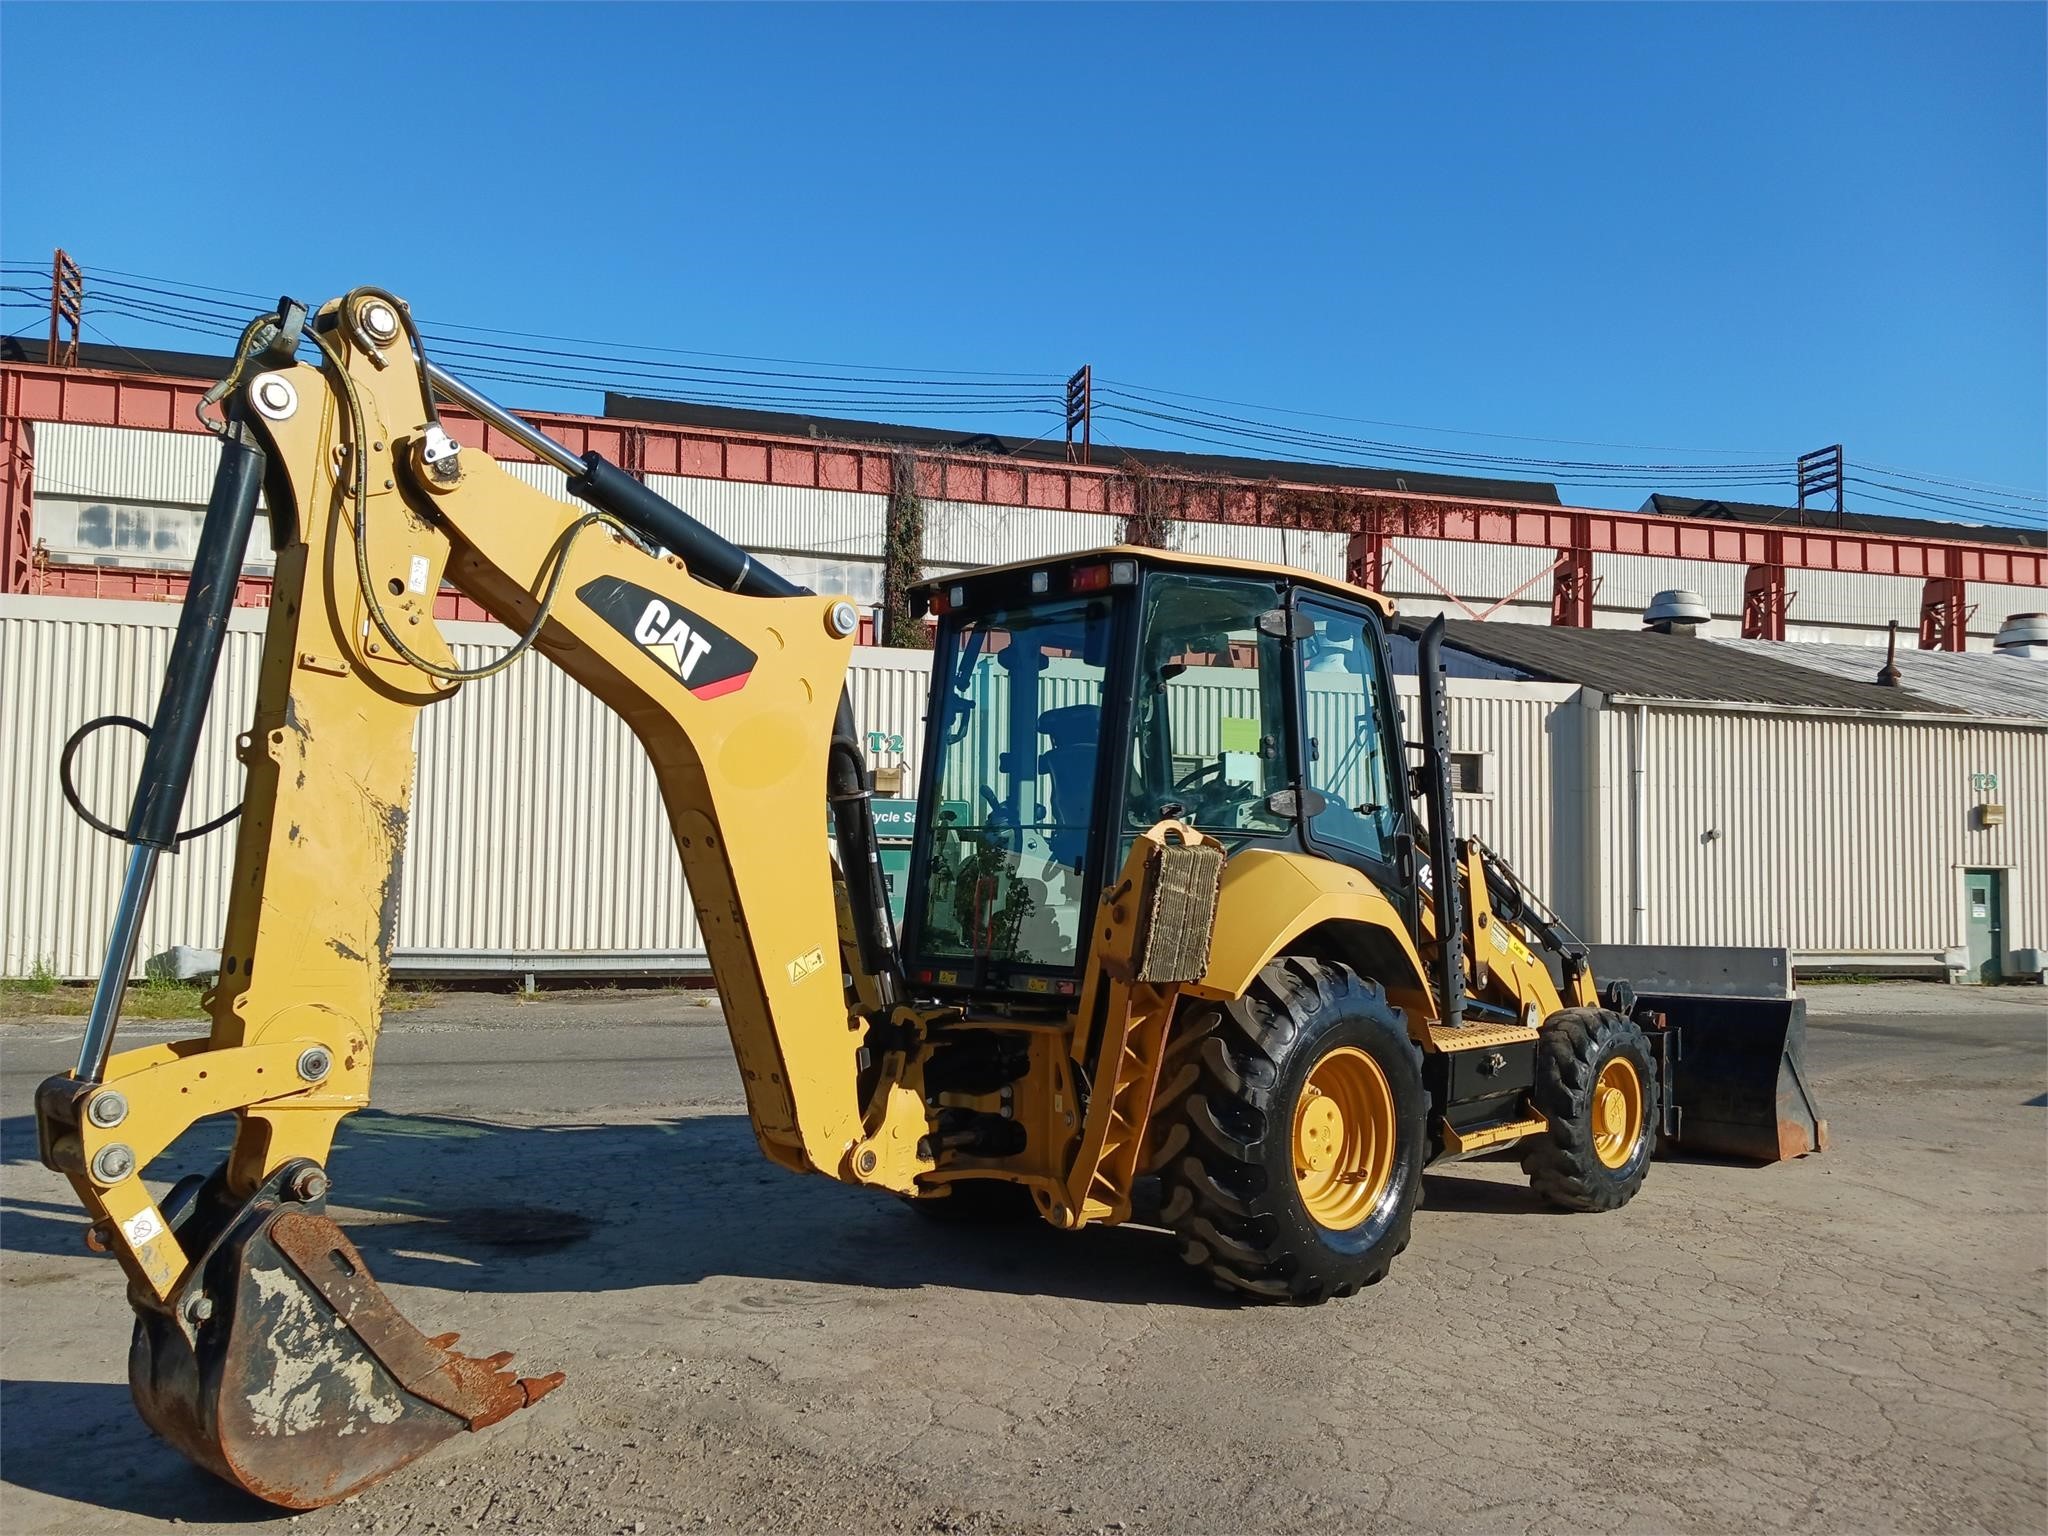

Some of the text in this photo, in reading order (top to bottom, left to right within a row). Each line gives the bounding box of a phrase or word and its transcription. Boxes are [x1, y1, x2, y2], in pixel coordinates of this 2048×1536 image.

[635, 599, 712, 681] CAT
[867, 731, 904, 753] T2
[872, 811, 900, 825] ycle
